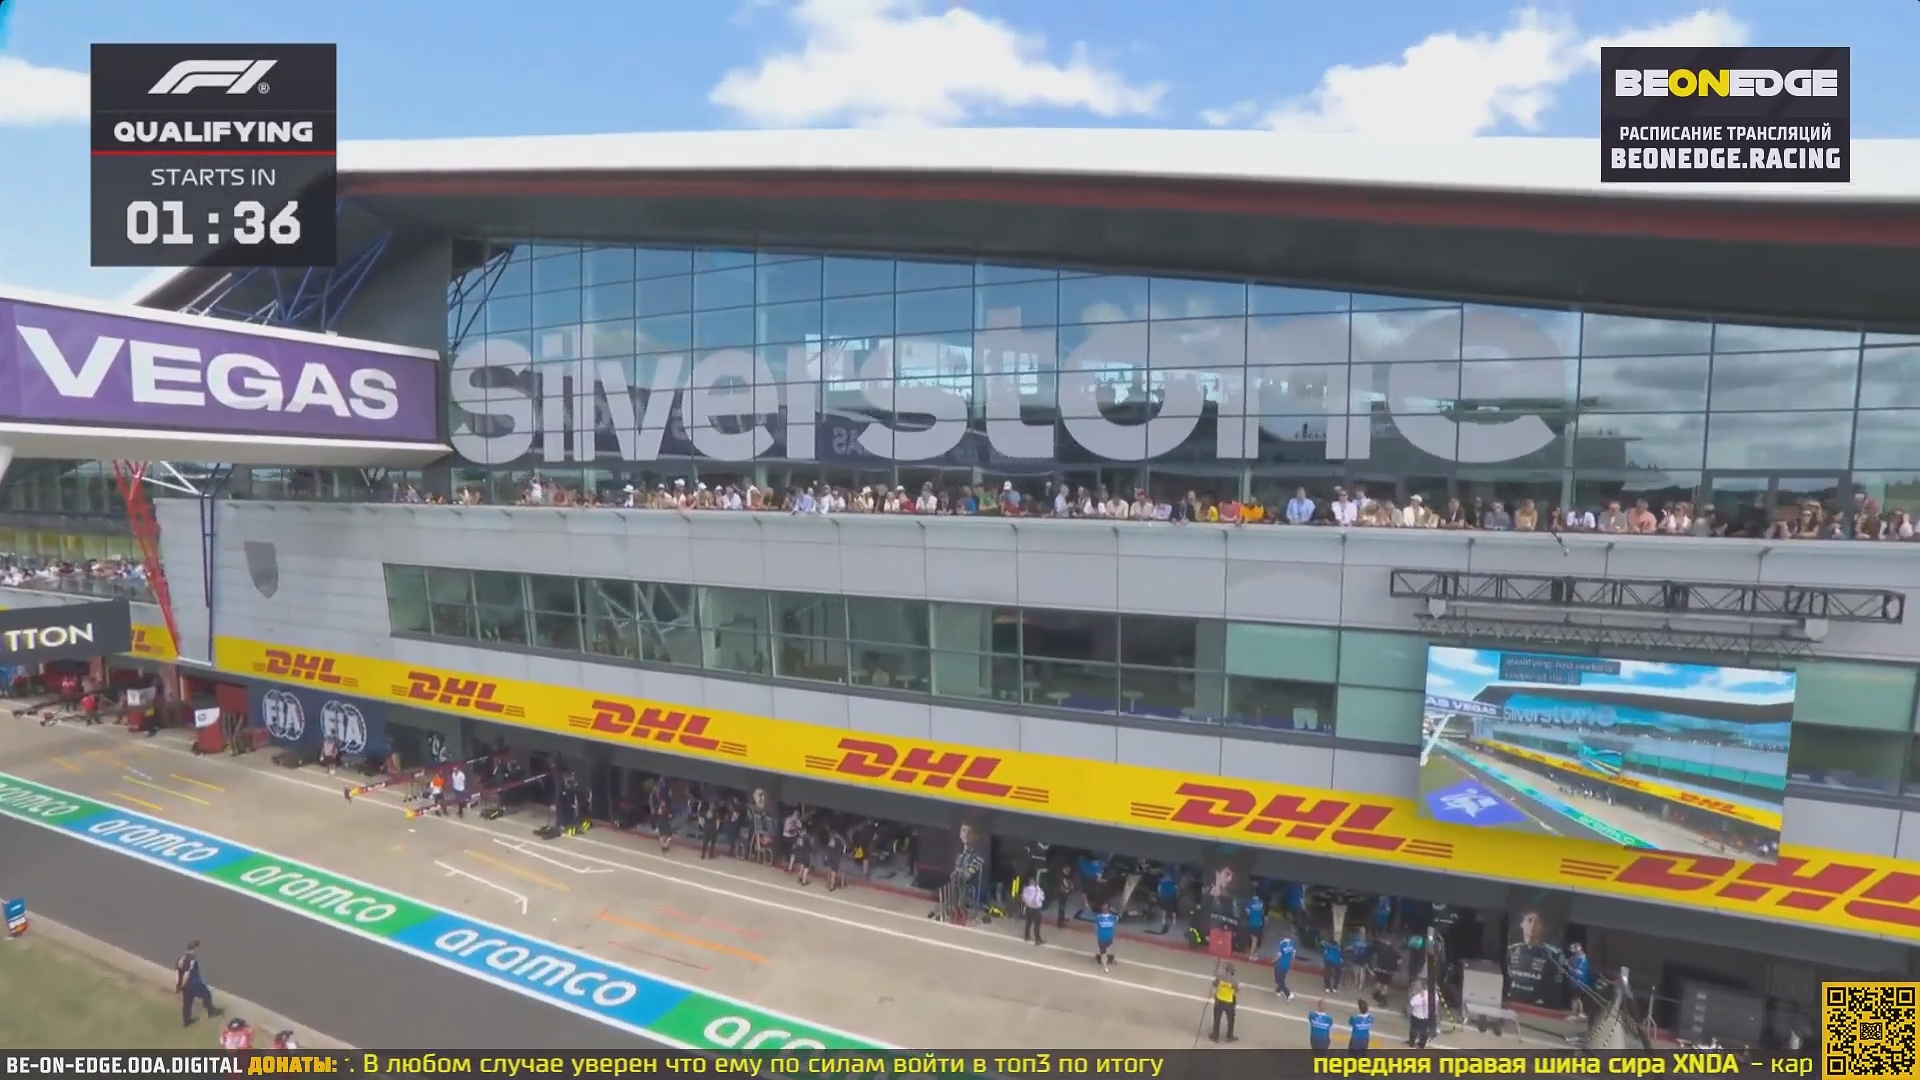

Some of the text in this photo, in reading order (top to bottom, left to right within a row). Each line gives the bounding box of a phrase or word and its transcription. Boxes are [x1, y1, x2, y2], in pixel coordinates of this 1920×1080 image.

[16, 324, 399, 420] VEGAS
[265, 648, 342, 685] DHL
[408, 671, 505, 713] DHL
[1453, 701, 1497, 715] VEGAS
[264, 695, 303, 737] FIA
[322, 704, 365, 748] FIA
[591, 700, 720, 750] DHL
[836, 737, 1011, 797] DHL
[0, 783, 79, 816] amco
[1171, 782, 1406, 852] DHL
[88, 819, 219, 862] aramco
[240, 866, 397, 923] aramco
[1613, 849, 1920, 928] DHL
[434, 929, 638, 1006] aramco
